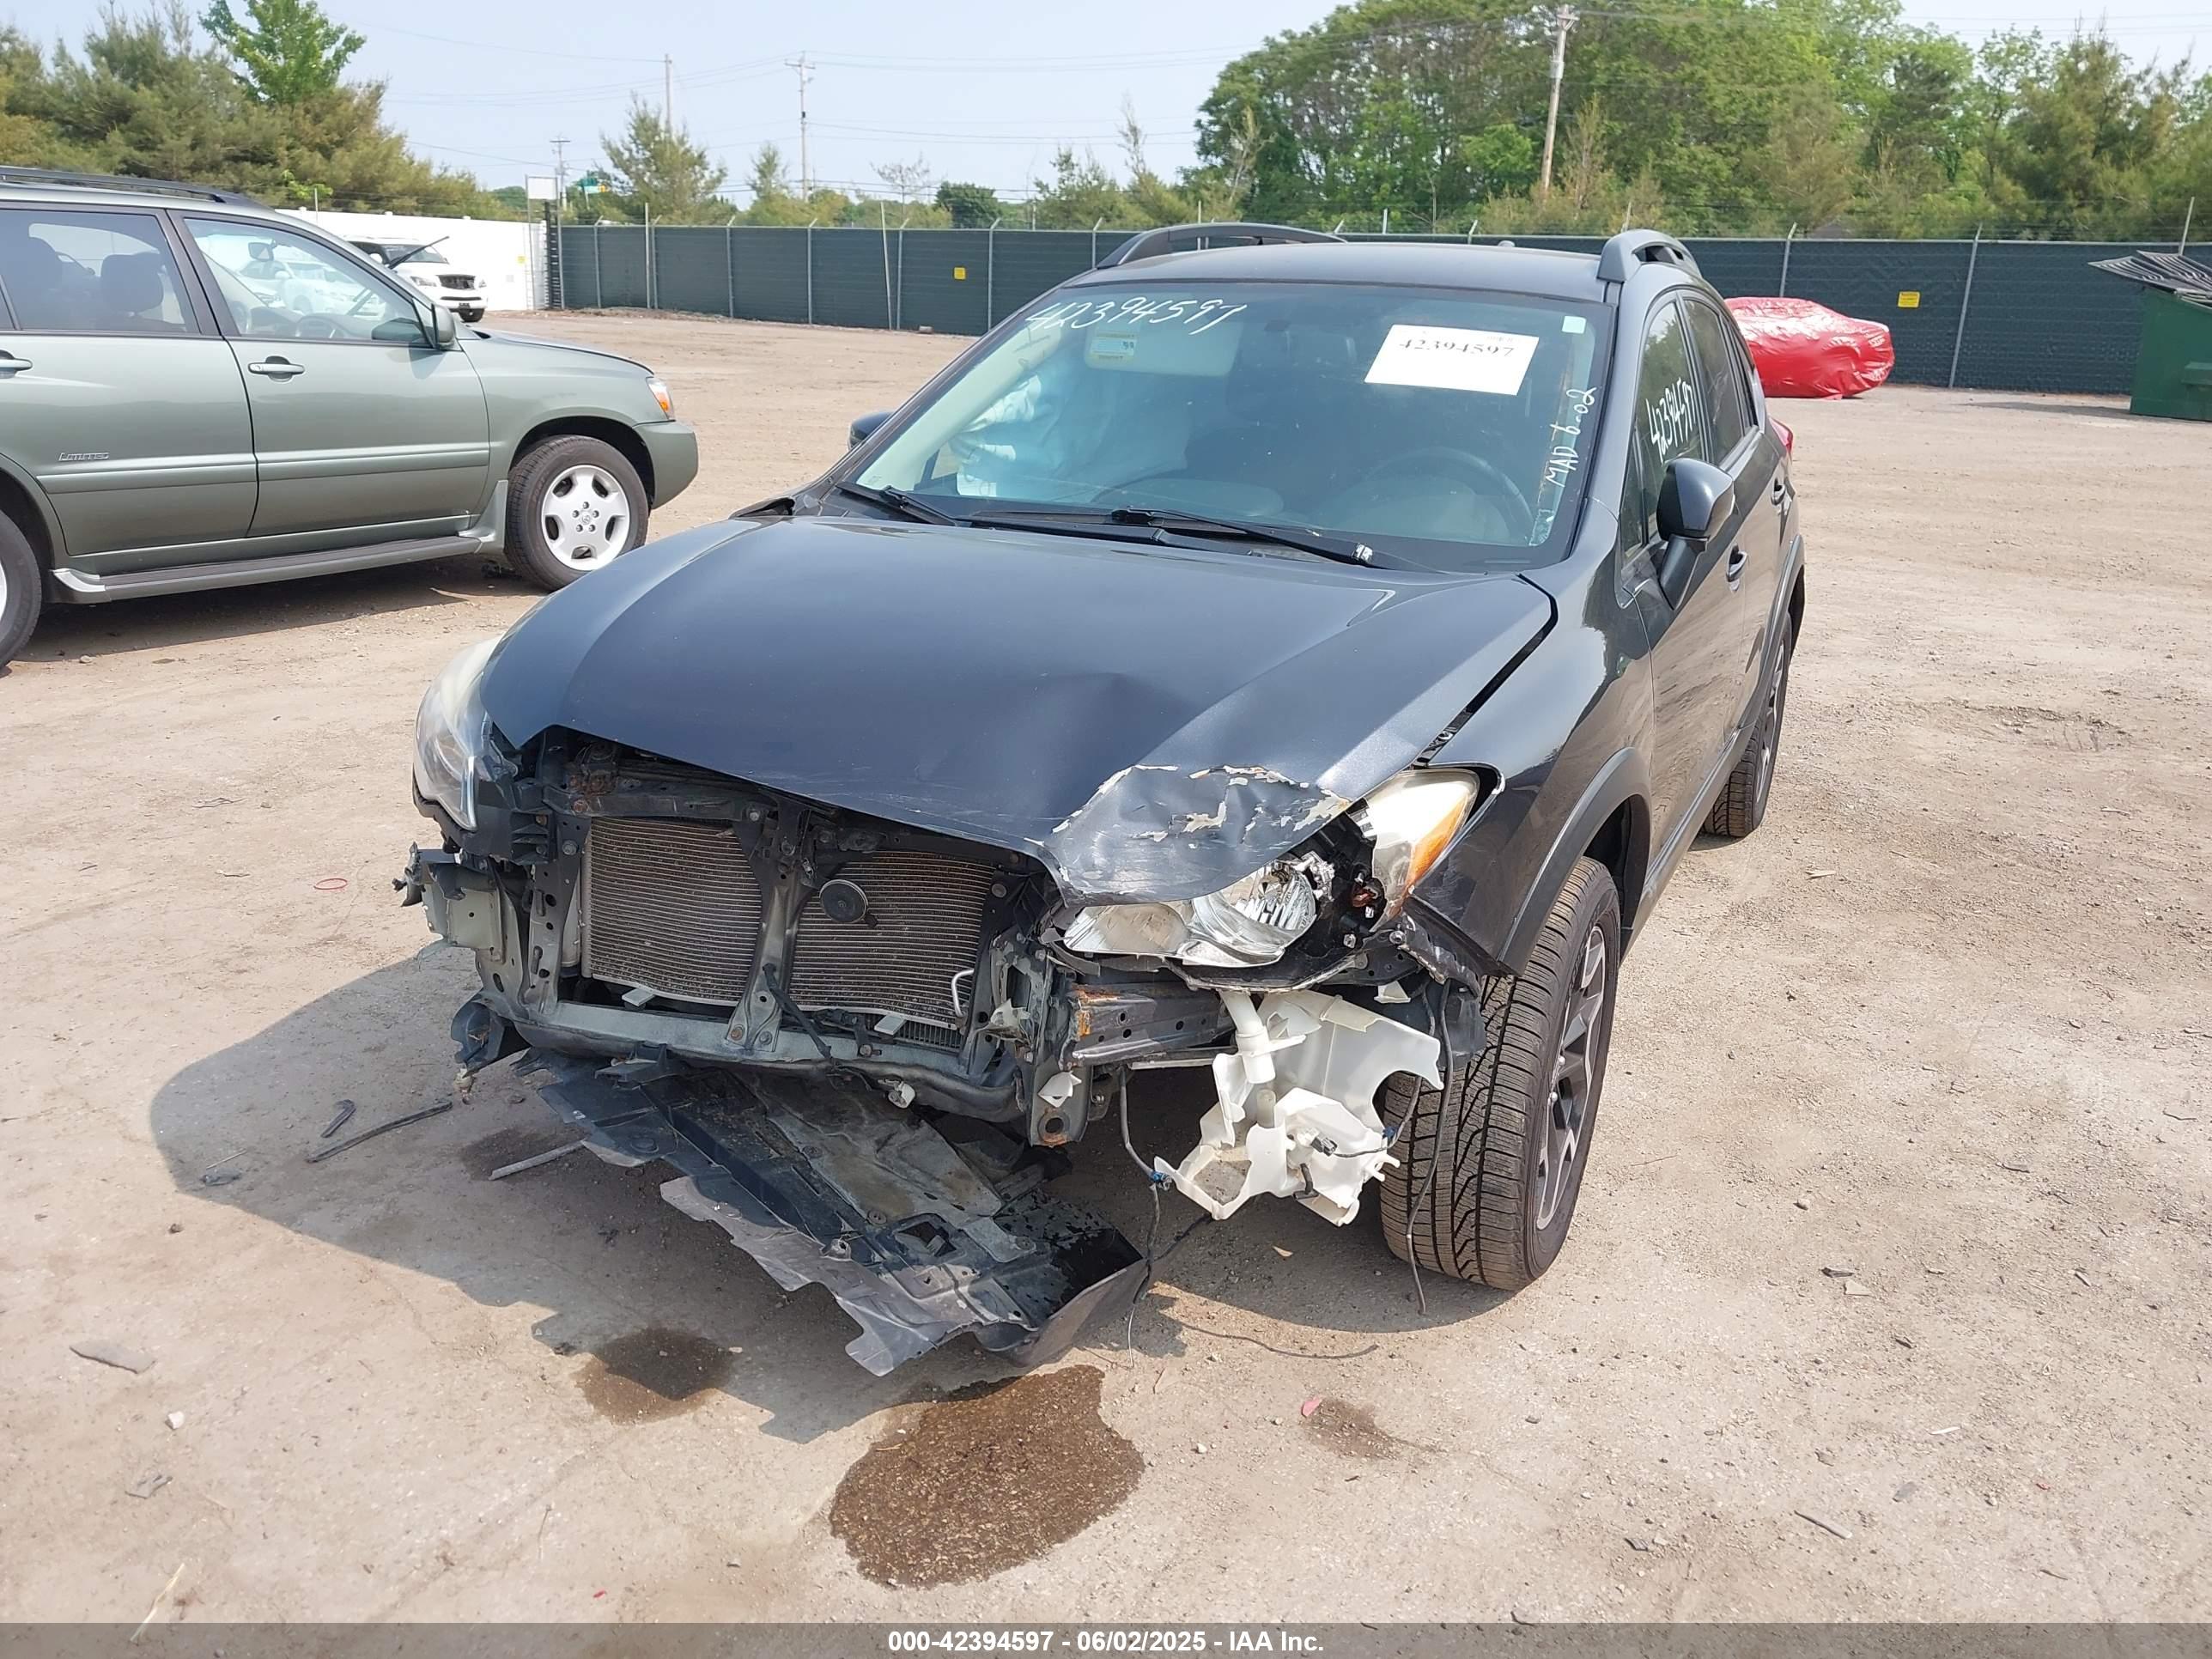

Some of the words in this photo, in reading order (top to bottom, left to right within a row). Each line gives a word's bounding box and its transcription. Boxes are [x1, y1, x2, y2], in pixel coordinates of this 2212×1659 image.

[1024, 296, 1248, 336] 42394597
[1399, 338, 1516, 357] 42394597
[1545, 446, 1579, 488] MAD
